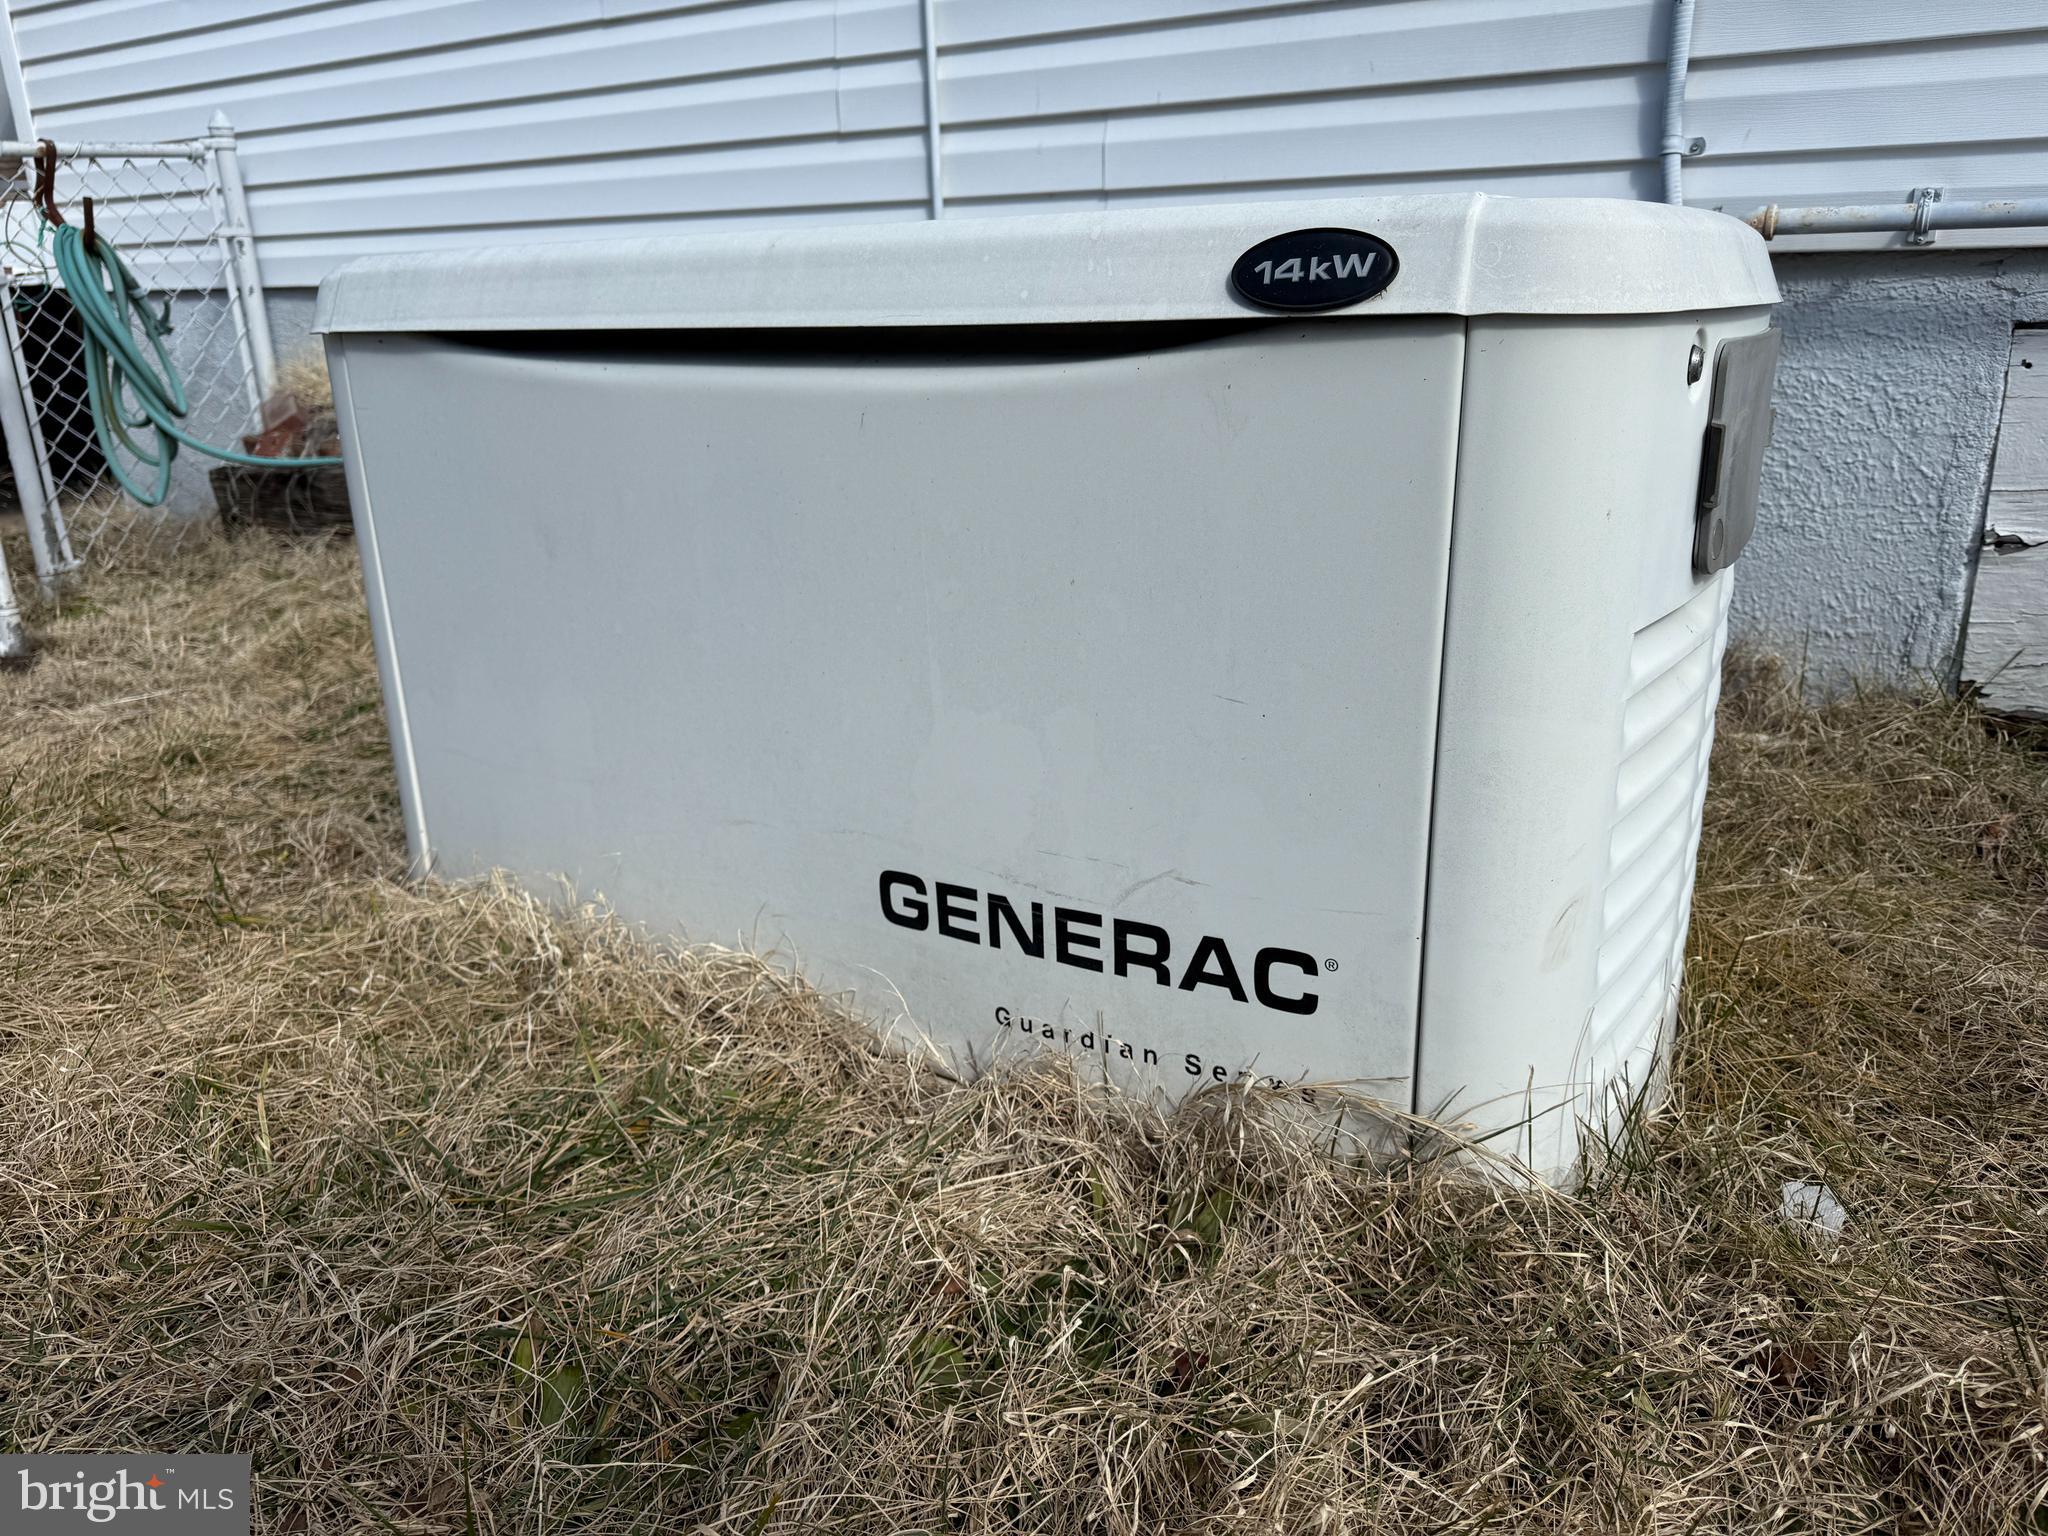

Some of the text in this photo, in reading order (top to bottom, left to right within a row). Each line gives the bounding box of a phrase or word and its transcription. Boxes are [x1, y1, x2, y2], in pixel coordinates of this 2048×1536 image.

[1254, 252, 1376, 285] 14kW
[879, 869, 1319, 1016] GENERAC
[995, 1006, 1158, 1066] Guardian
